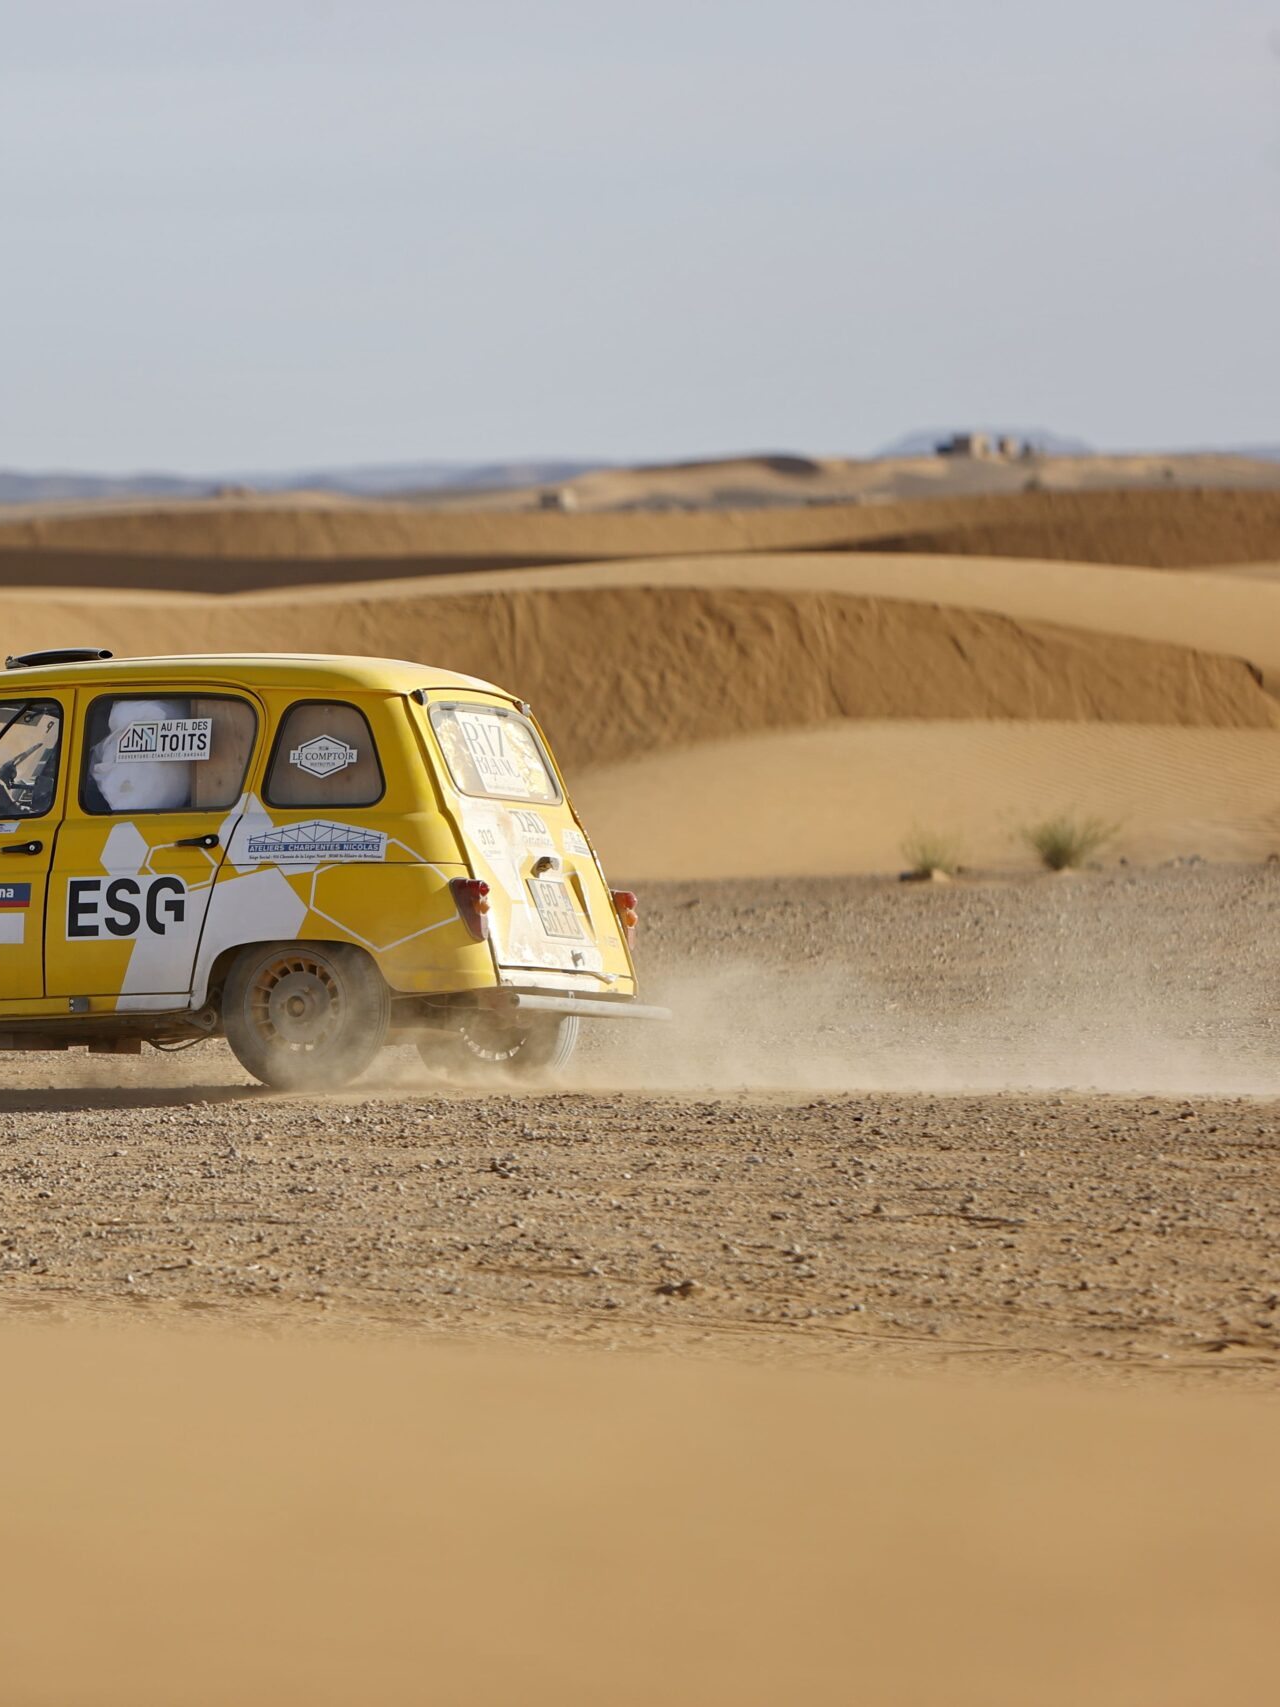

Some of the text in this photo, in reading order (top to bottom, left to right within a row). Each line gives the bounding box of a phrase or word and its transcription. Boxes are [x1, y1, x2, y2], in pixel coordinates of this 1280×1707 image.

[161, 721, 208, 732] AU FIL DES
[160, 733, 207, 752] TOITS
[293, 752, 354, 760] LE COMPTOIR
[477, 829, 496, 845] 313
[250, 844, 284, 852] ATELIERS
[68, 877, 185, 937] ESG
